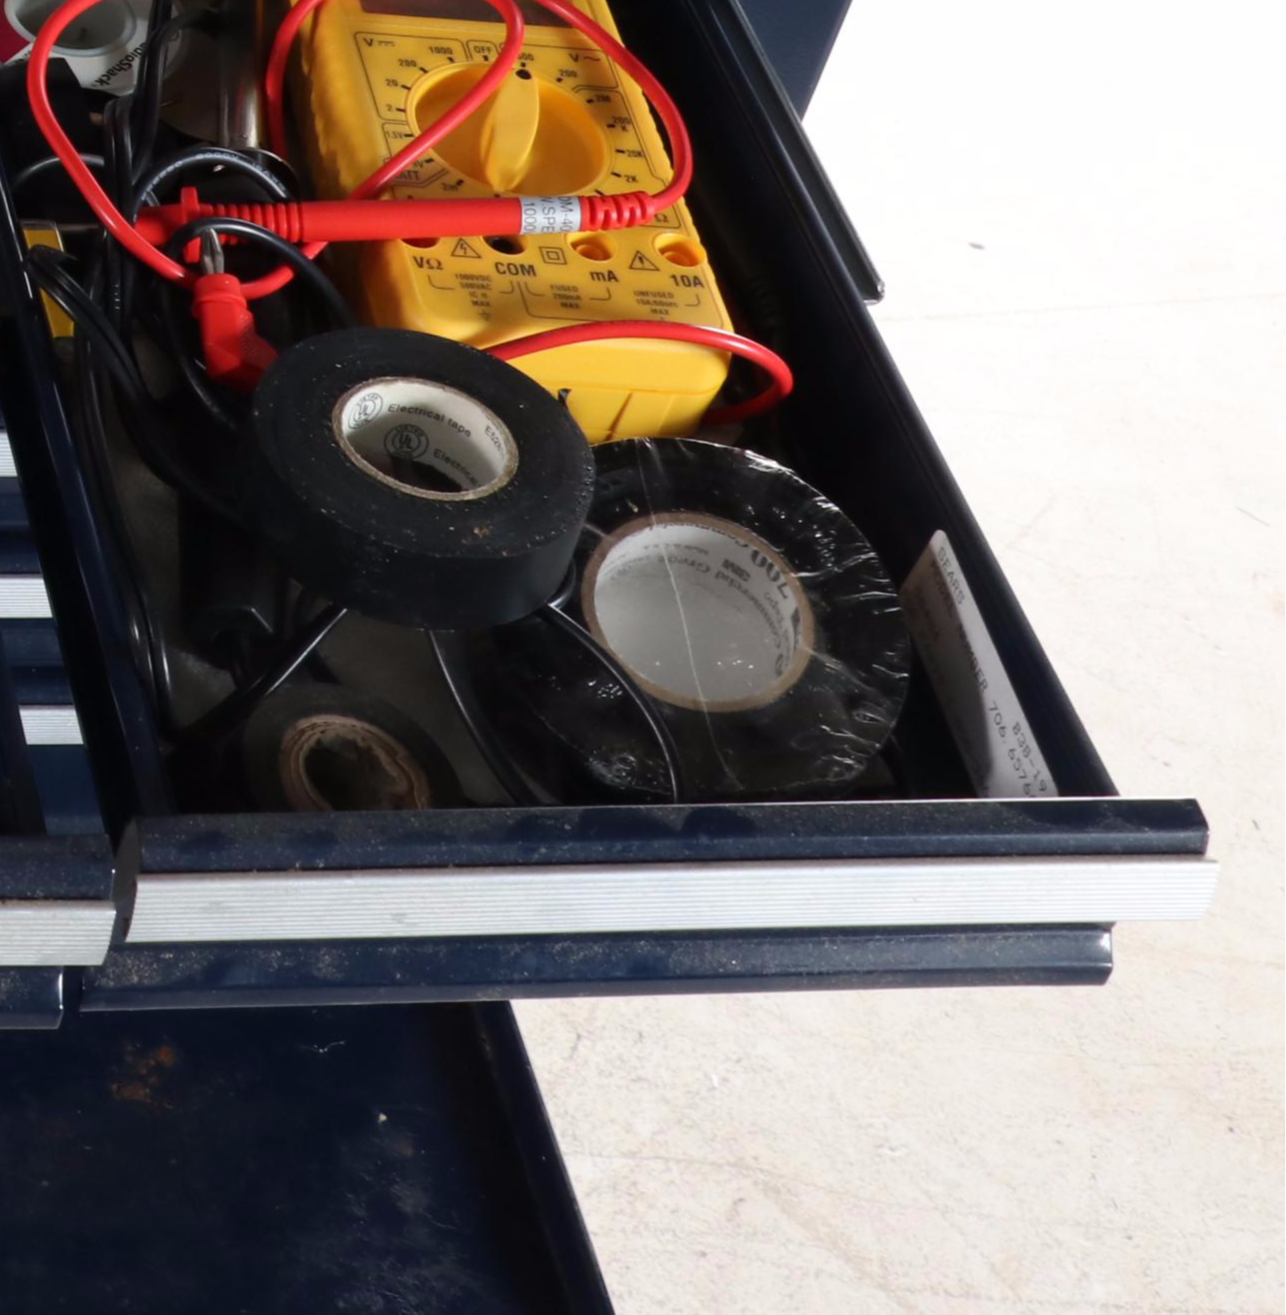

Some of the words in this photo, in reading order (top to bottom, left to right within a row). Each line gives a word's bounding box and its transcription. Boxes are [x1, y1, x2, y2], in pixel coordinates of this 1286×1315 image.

[363, 38, 373, 46] V
[429, 47, 453, 55] 1000
[474, 46, 492, 54] OFF
[569, 53, 580, 62] V
[398, 59, 417, 67] 200
[559, 69, 577, 78] 200
[385, 78, 398, 86] 20
[386, 131, 404, 139] 1.5V
[626, 175, 639, 183] 2K
[413, 256, 444, 270] VΩ
[495, 262, 537, 277] COM
[590, 270, 620, 282] mA
[670, 274, 704, 288] 10A
[550, 285, 579, 293] FUSED
[633, 290, 674, 298] UNFUSED
[560, 301, 581, 309] MAX
[388, 403, 444, 423] Electrical
[448, 417, 471, 438] tape
[399, 435, 413, 451] UL
[658, 556, 711, 574] Grade
[937, 547, 966, 604] SEARS
[715, 571, 782, 649] Commercial
